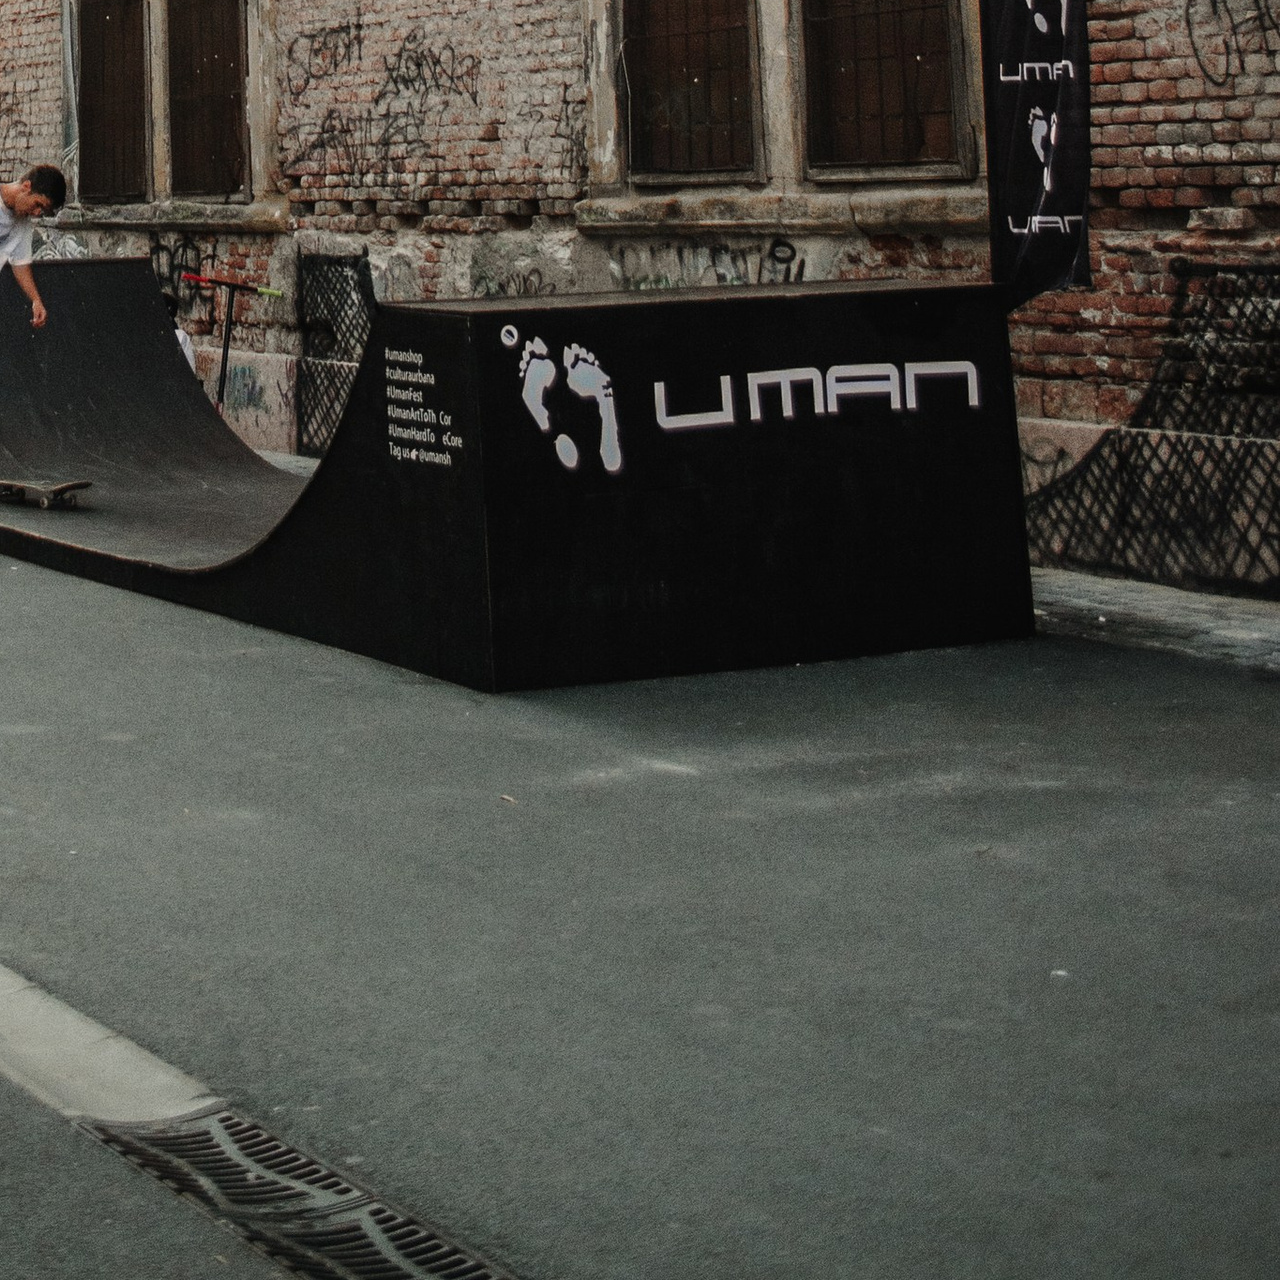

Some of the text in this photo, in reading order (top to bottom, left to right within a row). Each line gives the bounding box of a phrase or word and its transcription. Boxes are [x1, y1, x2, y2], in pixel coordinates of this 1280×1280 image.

[385, 347, 423, 366] #umanshop
[385, 366, 435, 384] #culturaurbana
[386, 385, 423, 403] #UmanFest
[654, 361, 979, 429] UMAN
[389, 442, 402, 460] Tag
[402, 447, 410, 459] us
